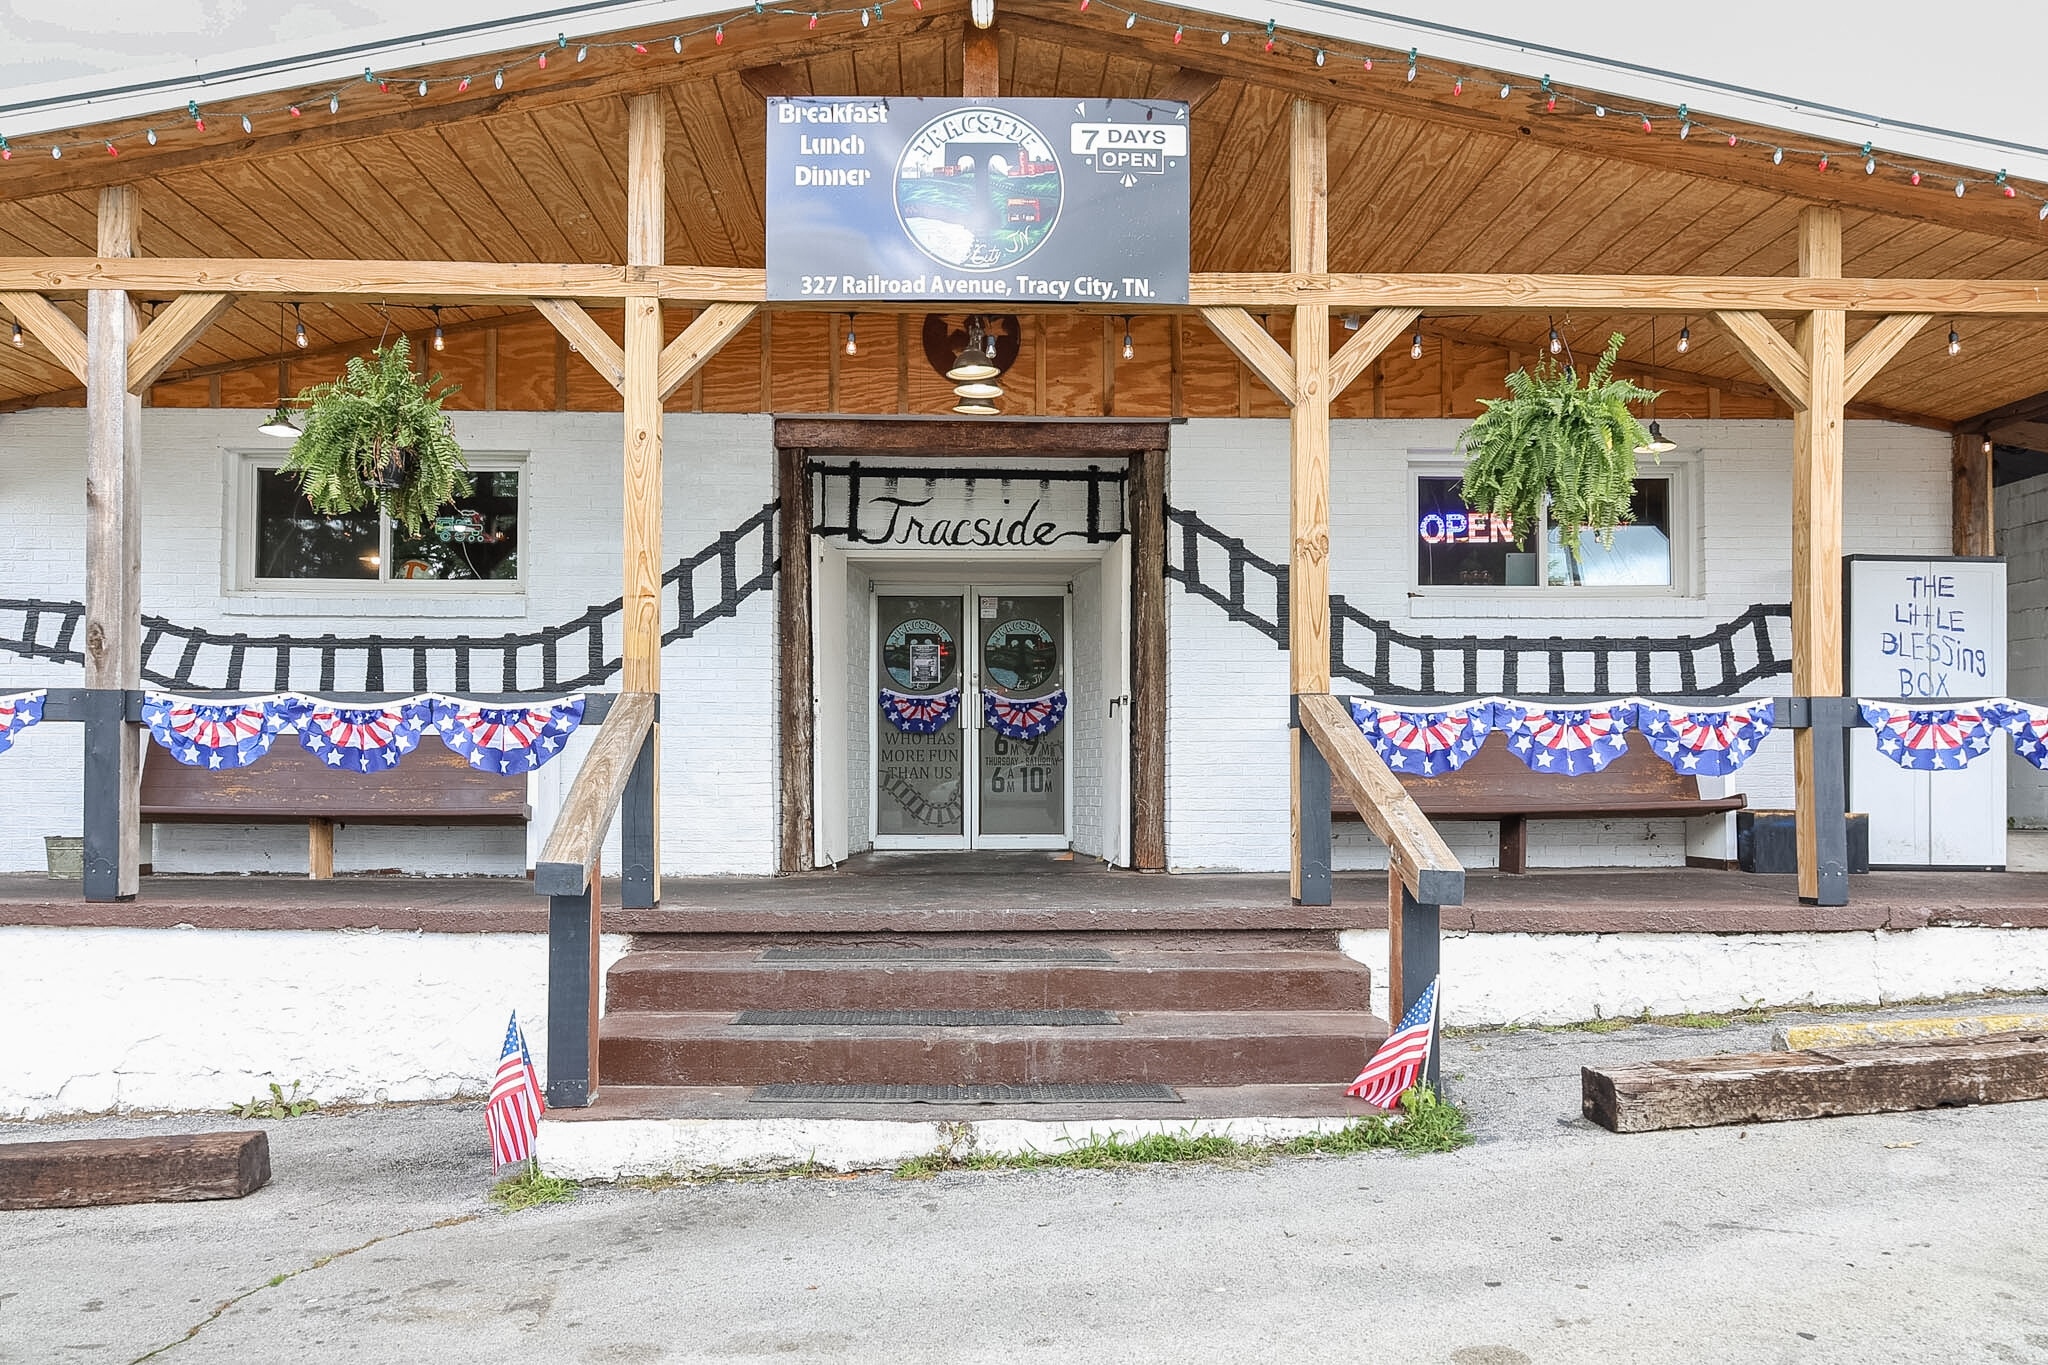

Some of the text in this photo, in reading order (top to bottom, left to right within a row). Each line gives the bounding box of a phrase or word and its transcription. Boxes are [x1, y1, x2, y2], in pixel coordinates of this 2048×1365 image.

[778, 103, 888, 124] Breakfast
[800, 134, 865, 155] Lunch
[913, 113, 1037, 156] TRACSIDE
[1081, 129, 1166, 151] 7 DAYS
[1102, 151, 1157, 168] OPEN
[794, 165, 871, 186] Dinner
[800, 274, 1156, 300] 327 Railroad Avenue, Tracy City, TN.
[863, 496, 1057, 546] Tracside
[1419, 512, 1515, 544] OPEN
[1905, 574, 1956, 599] THE
[1896, 668, 1951, 698] BOX
[885, 732, 956, 745] WHO HAS
[881, 749, 959, 762] MORE FUN
[985, 756, 1019, 766] THURSDAY
[1025, 756, 1058, 766] SATURDAY
[887, 766, 953, 780] THAN US
[991, 766, 1005, 793] 6
[1020, 766, 1044, 793] 10
